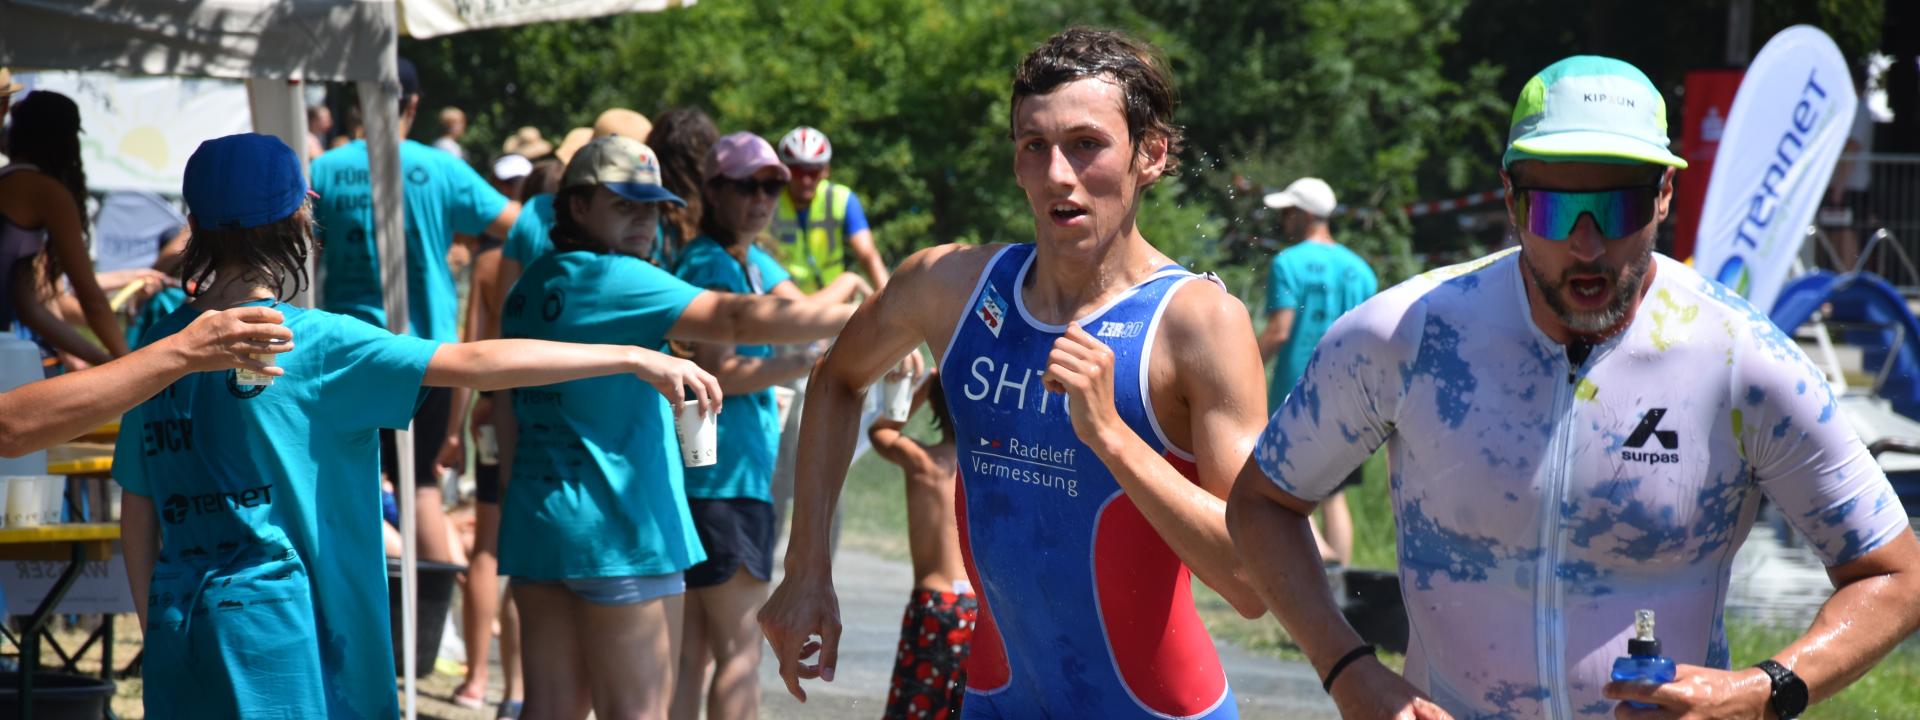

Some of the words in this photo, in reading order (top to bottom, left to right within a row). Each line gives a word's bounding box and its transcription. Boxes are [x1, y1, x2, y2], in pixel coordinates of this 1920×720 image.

[964, 356, 1070, 416] SHT
[1009, 438, 1076, 465] Radeleff
[1621, 451, 1680, 466] surpas
[972, 456, 1078, 497] Vermessung
